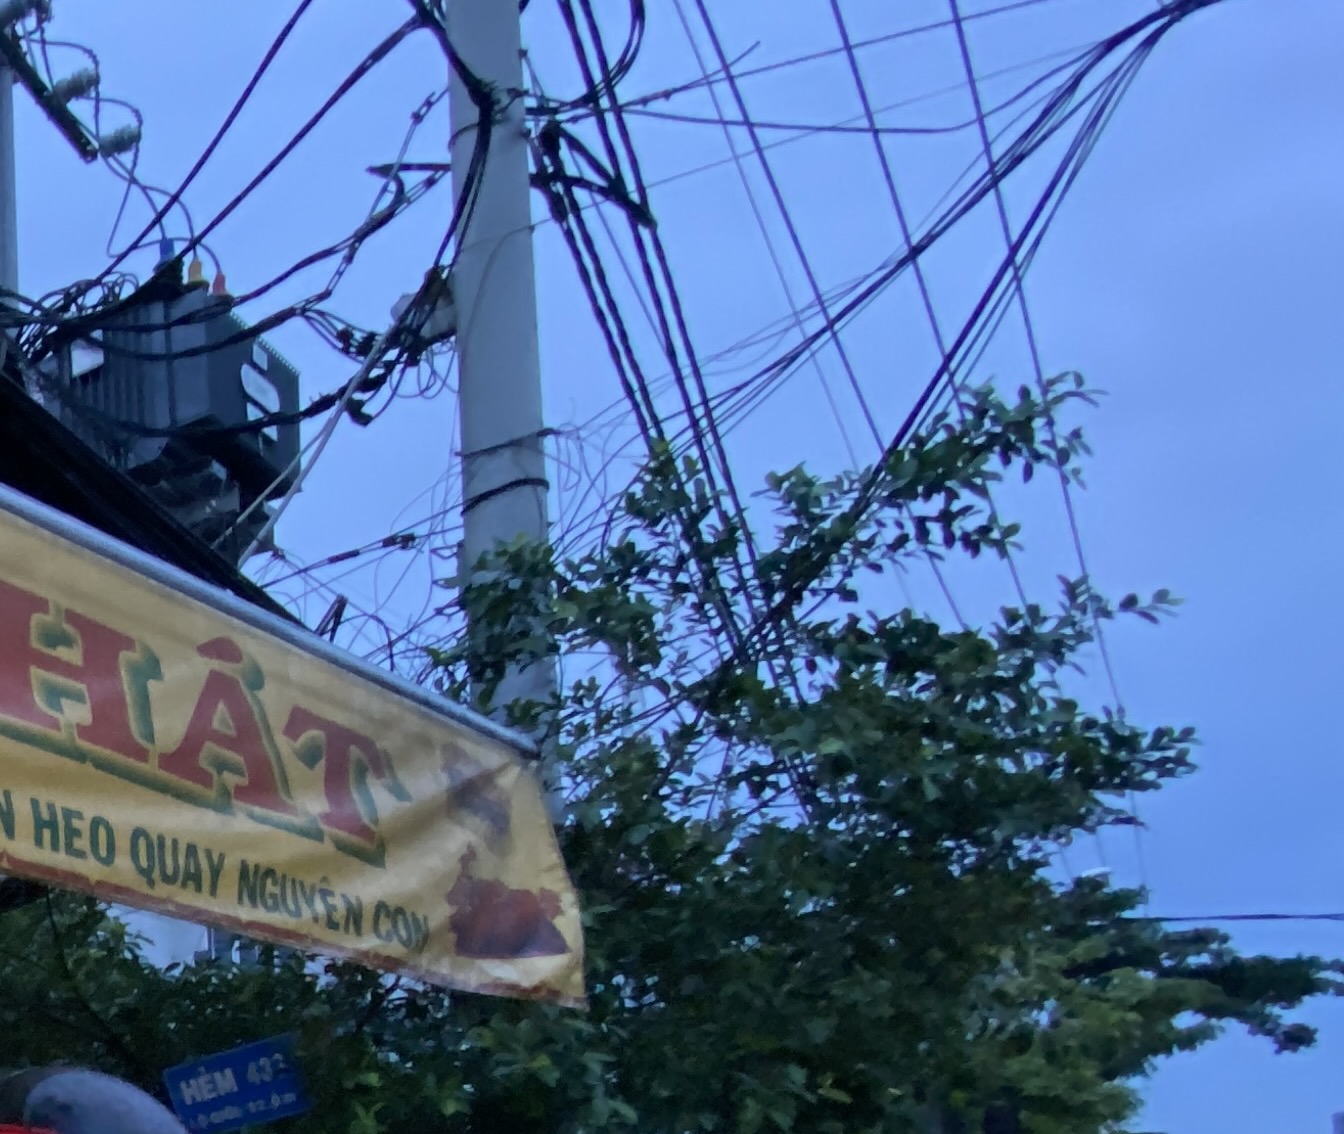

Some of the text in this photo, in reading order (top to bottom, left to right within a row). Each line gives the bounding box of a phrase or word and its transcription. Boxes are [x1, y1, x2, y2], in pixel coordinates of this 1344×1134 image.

[30, 797, 116, 868] HEO
[130, 826, 226, 898] QUAY
[237, 858, 364, 936] NGUYÊN
[372, 899, 430, 954] CON
